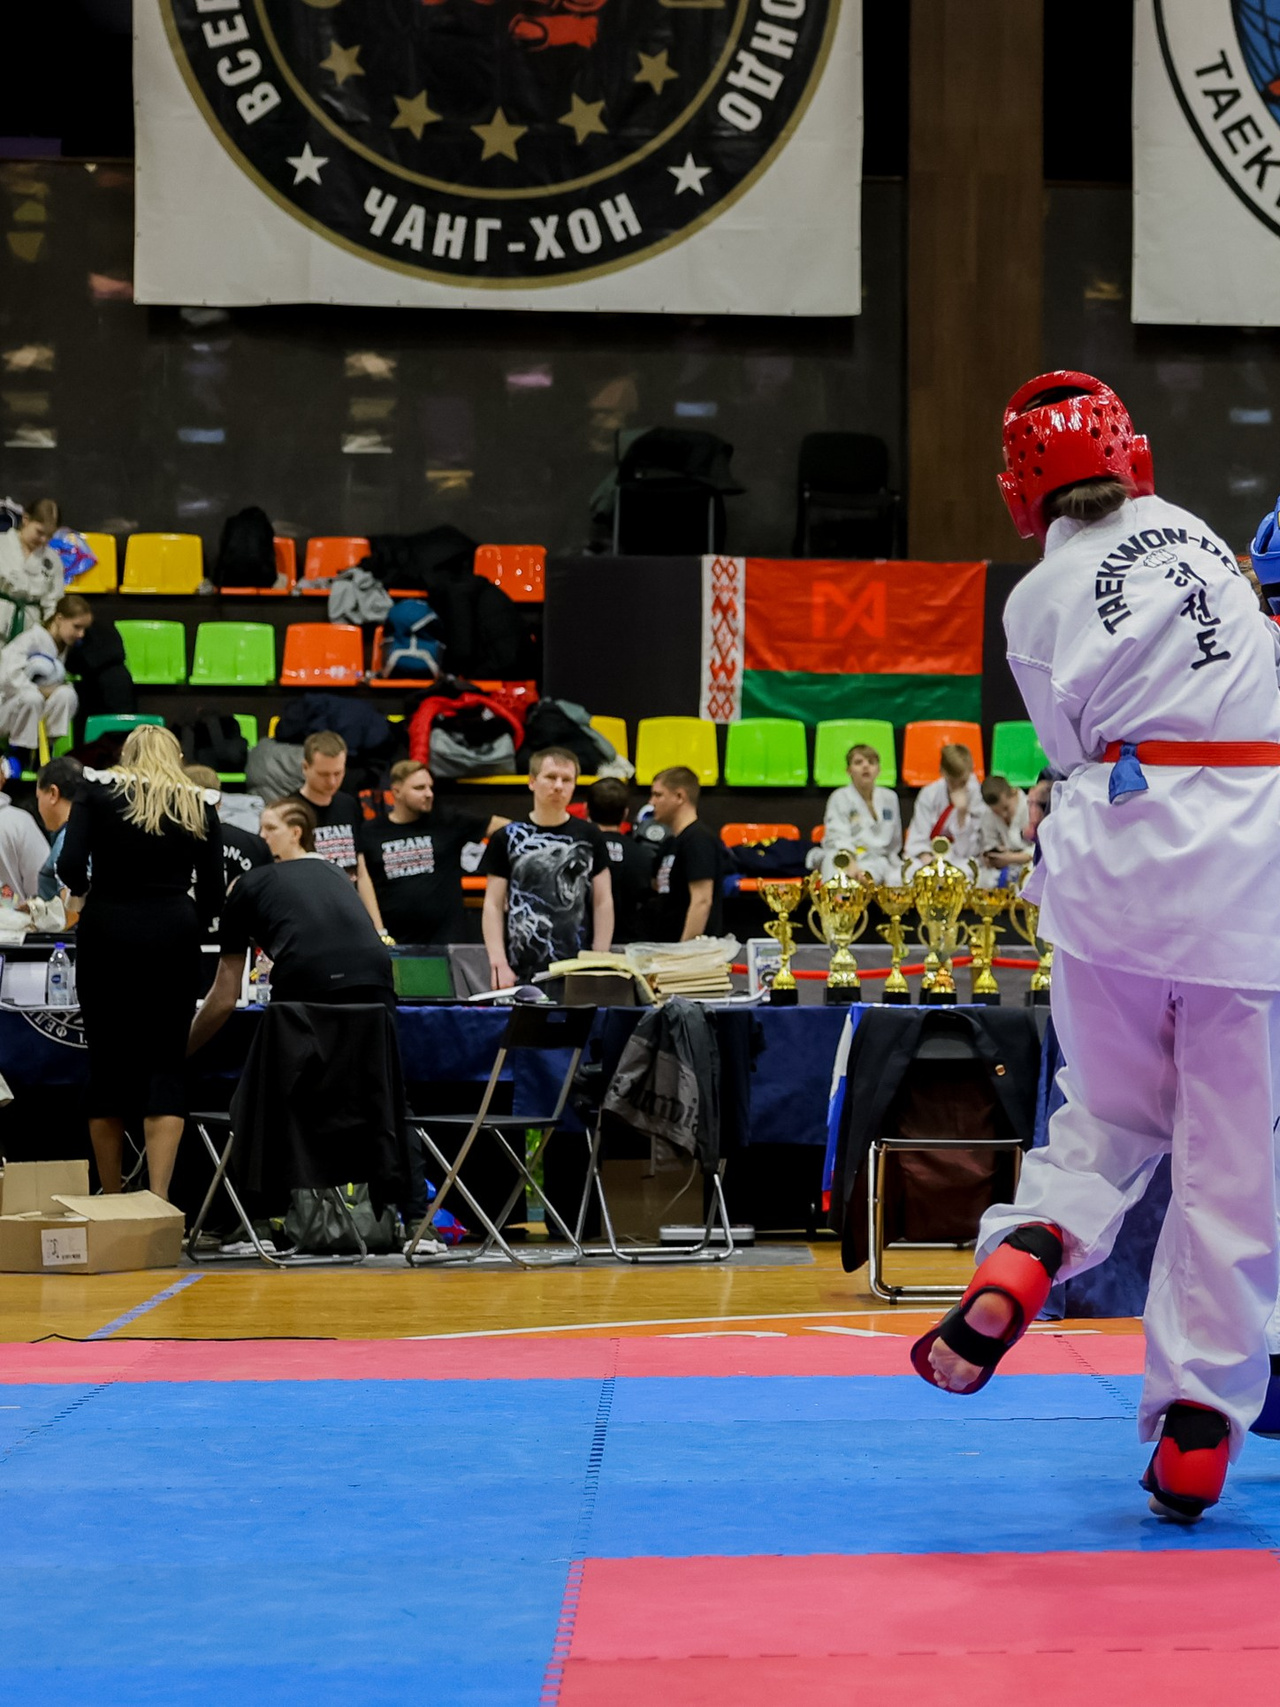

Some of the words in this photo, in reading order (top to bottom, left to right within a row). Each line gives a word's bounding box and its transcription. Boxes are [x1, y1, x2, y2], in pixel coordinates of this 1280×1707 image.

[363, 186, 643, 263] ЧАНГ-ХОН
[1095, 528, 1241, 636] TAEKWON-DO
[312, 824, 353, 842] TEAM
[381, 836, 433, 853] TEAM
